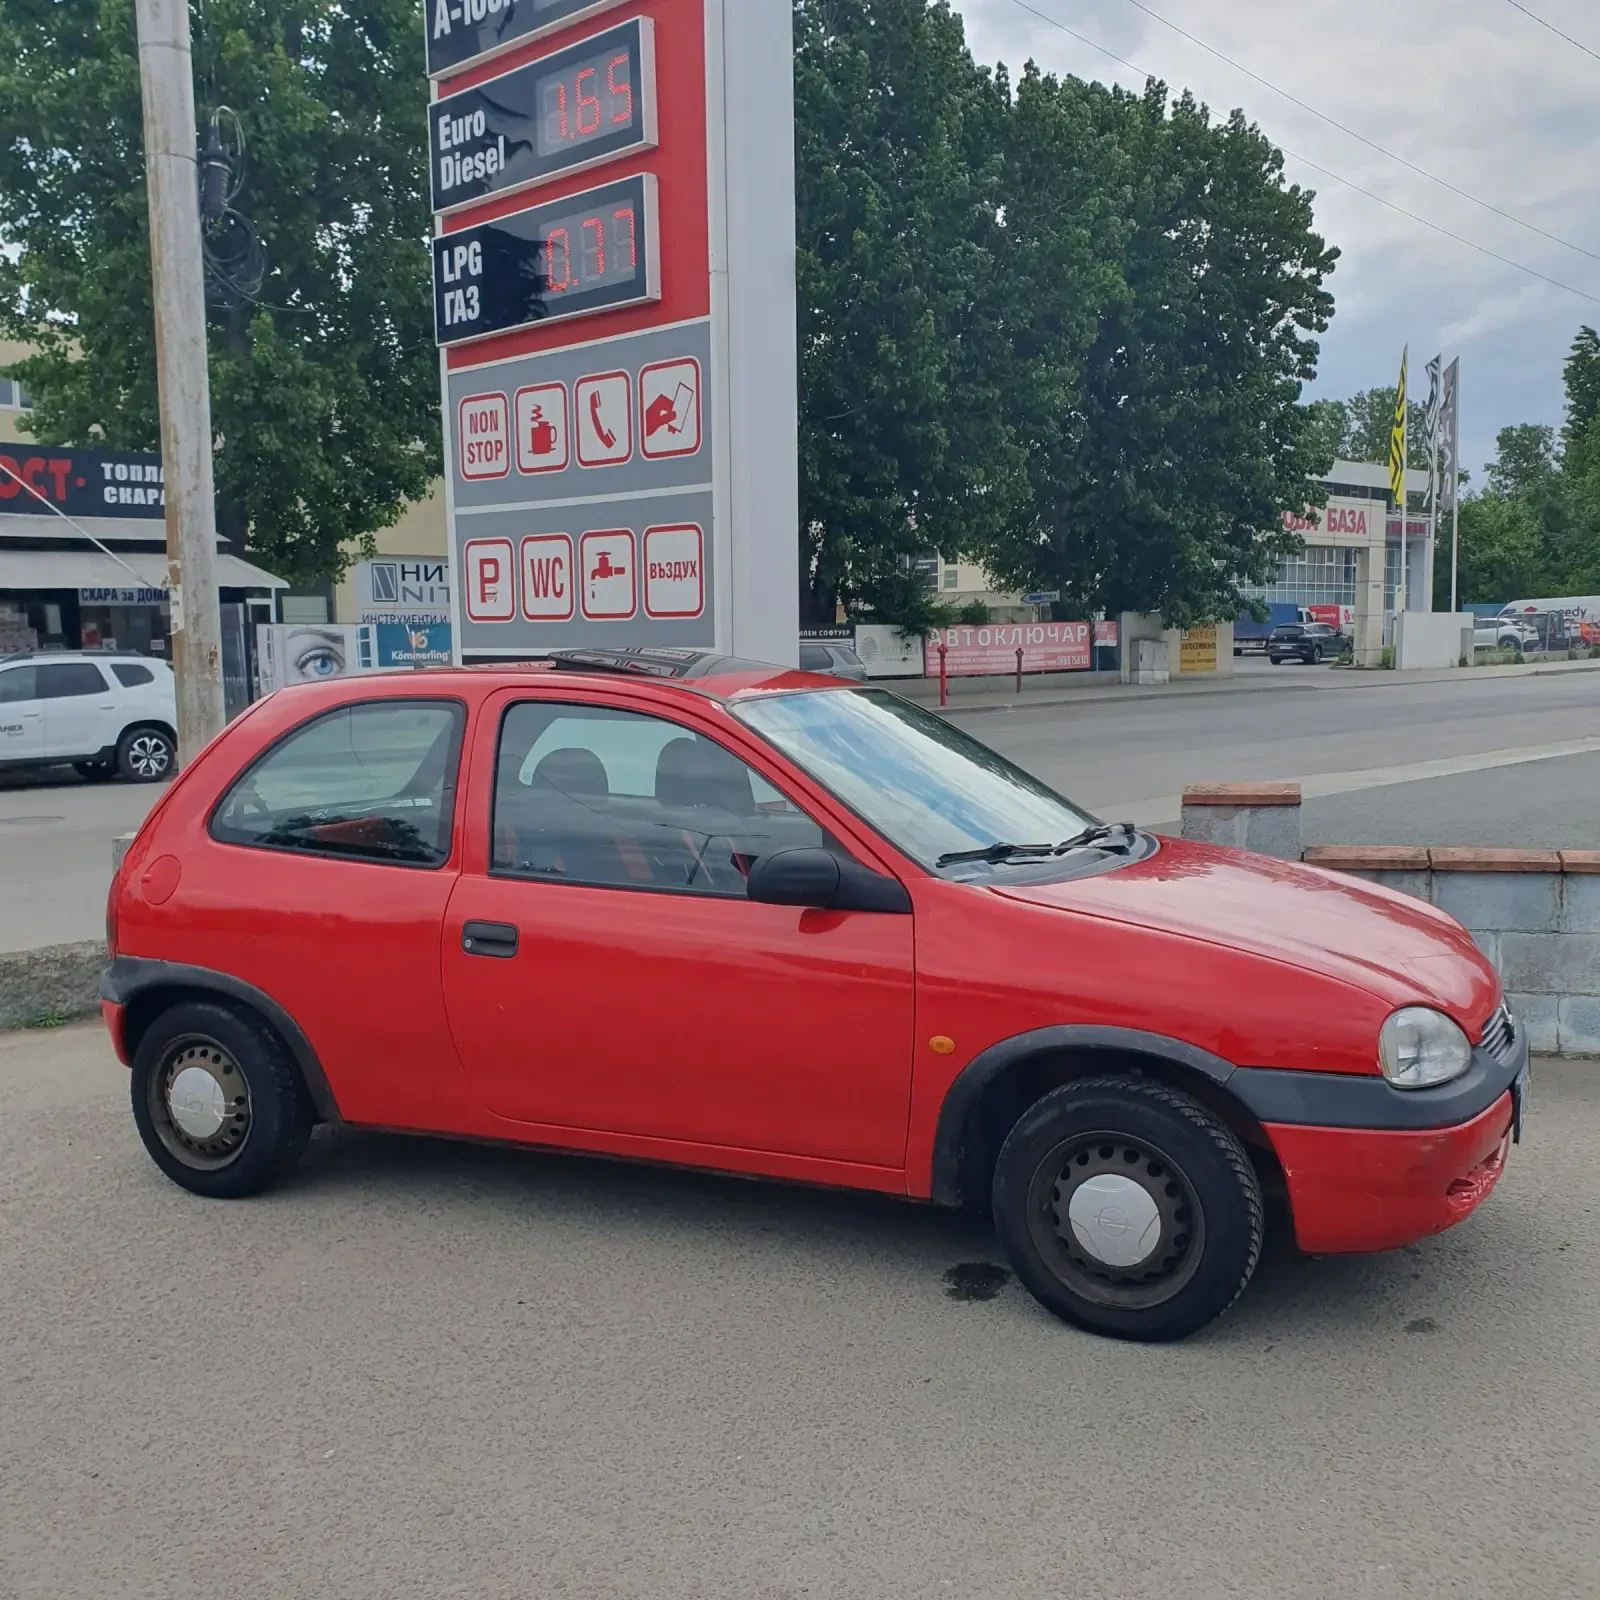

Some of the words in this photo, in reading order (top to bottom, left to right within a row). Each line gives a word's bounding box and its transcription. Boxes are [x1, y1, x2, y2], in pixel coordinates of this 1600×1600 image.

[433, 0, 520, 40] A-10
[555, 54, 633, 140] 1.65
[439, 109, 486, 150] Euro
[440, 135, 506, 191] Diesel
[442, 240, 483, 284] LPG
[545, 207, 637, 291] 0.77
[444, 285, 480, 326] ГАЗ
[469, 409, 499, 436] NON
[467, 439, 504, 465] STOP
[101, 463, 165, 483] ТОПЛ
[104, 486, 166, 506] СКАР
[1326, 507, 1367, 535] БАЗА
[401, 563, 449, 582] НИ
[530, 556, 565, 599] WC
[650, 560, 698, 582] ВЪЗДУХ
[81, 587, 118, 601] СКАРА
[121, 591, 134, 601] за
[362, 613, 437, 625] ИНСТРУМЕНТИ
[818, 629, 851, 637] СОФТУЕР
[928, 625, 1088, 648] АВТОКЛЮЧАР
[391, 650, 448, 661] Kömmerling
